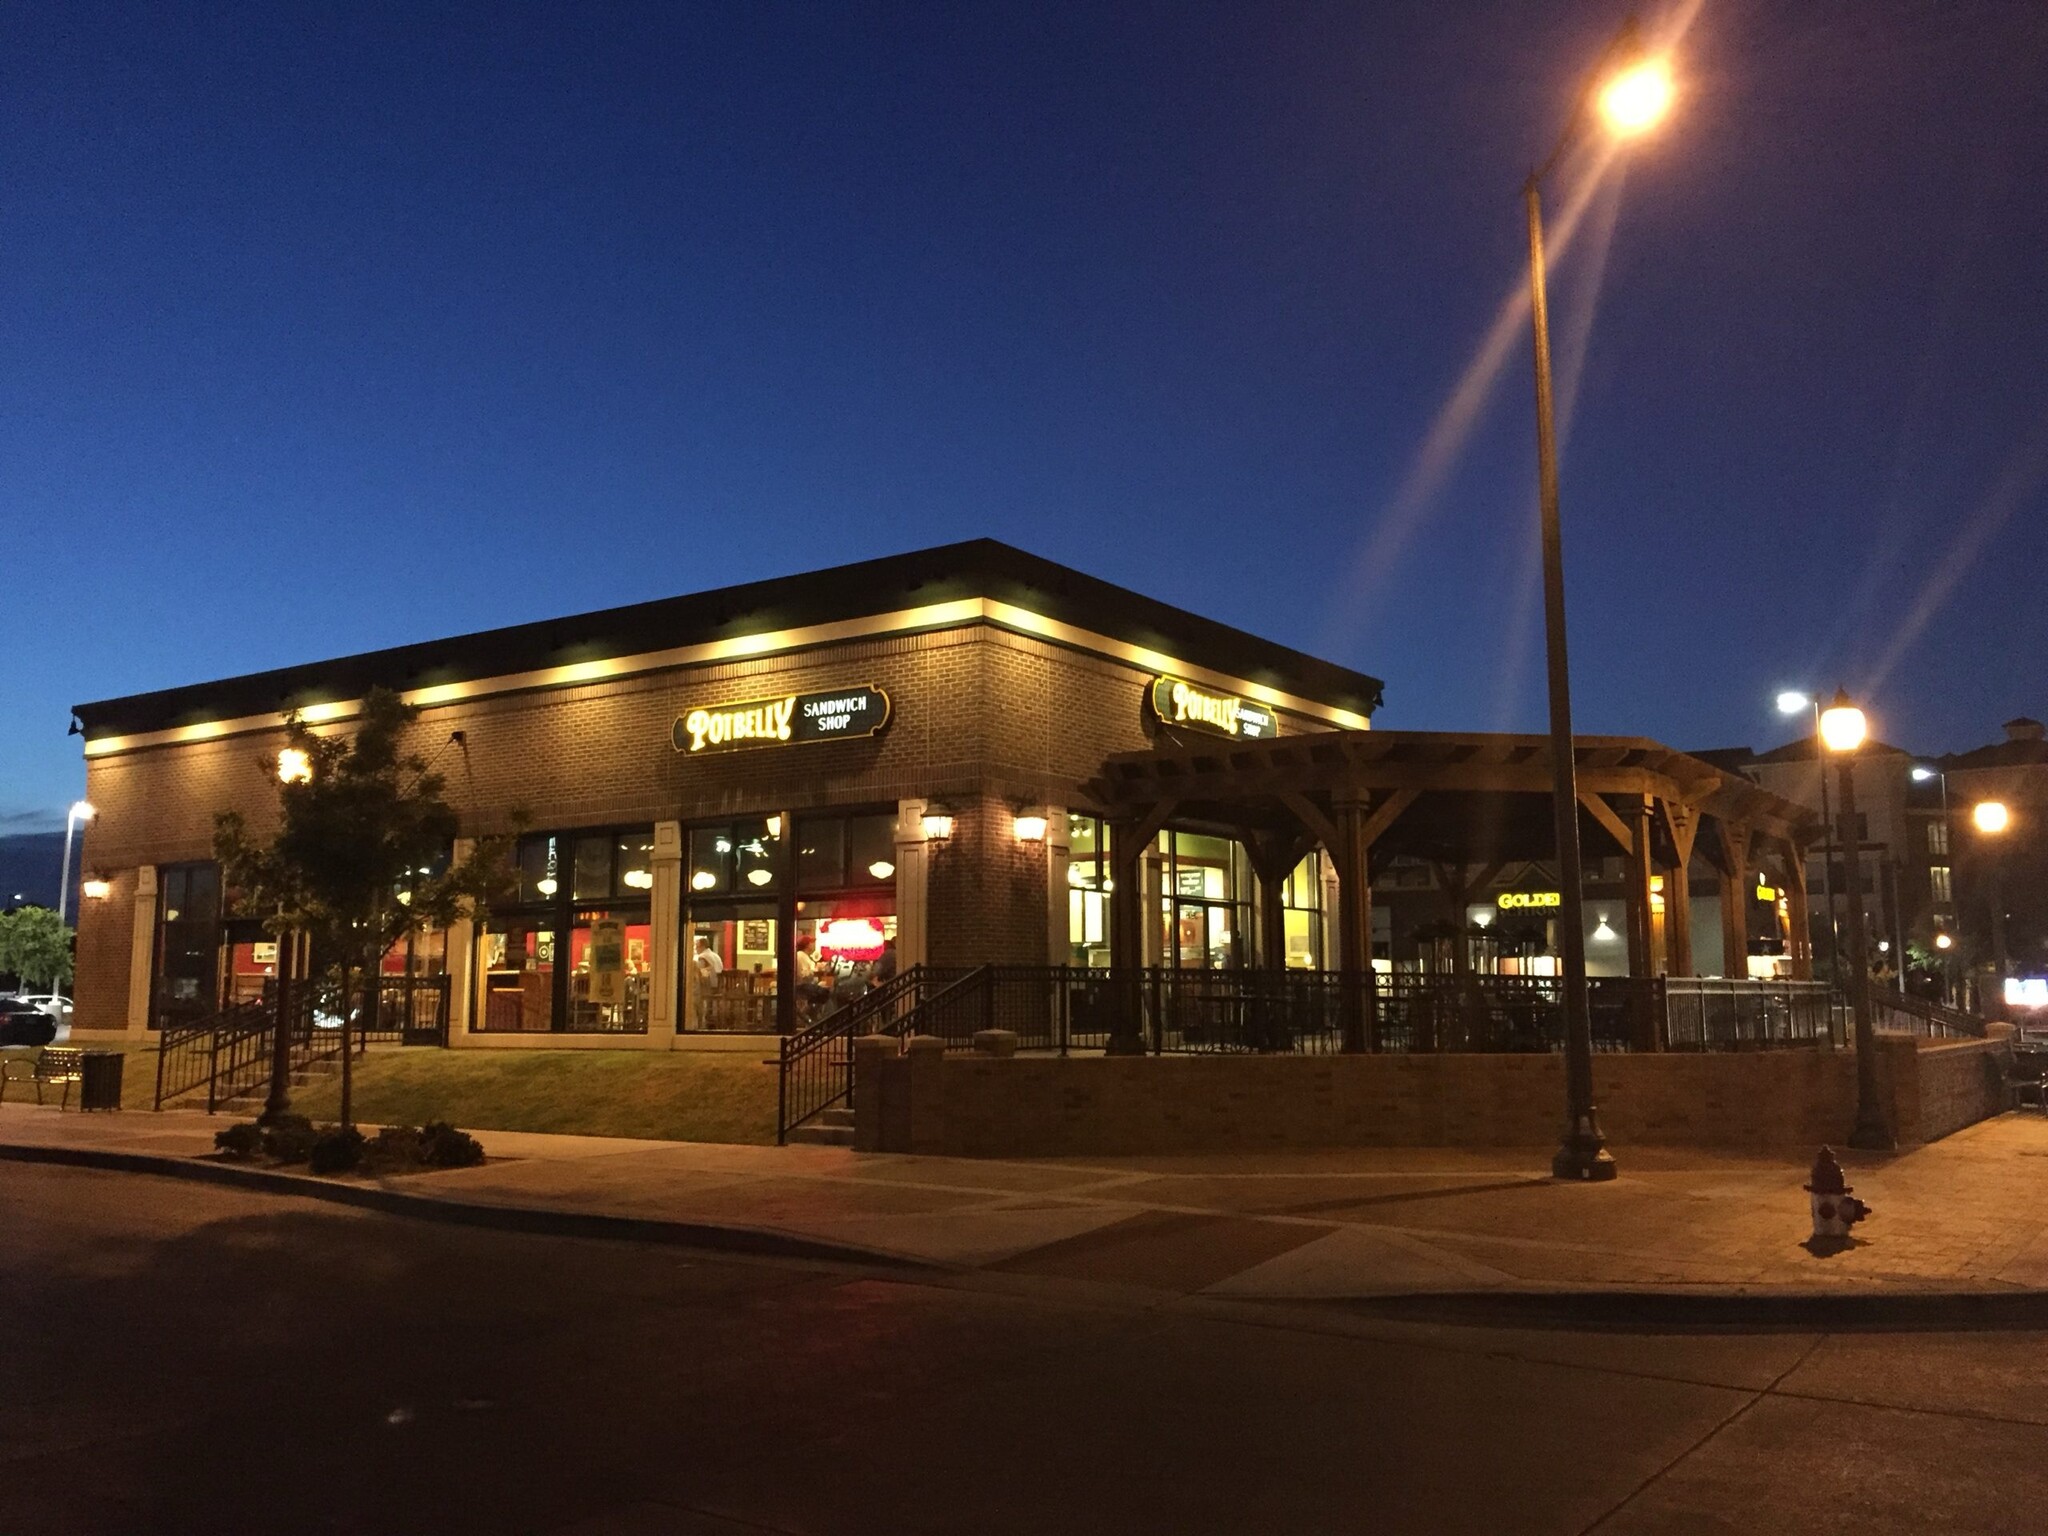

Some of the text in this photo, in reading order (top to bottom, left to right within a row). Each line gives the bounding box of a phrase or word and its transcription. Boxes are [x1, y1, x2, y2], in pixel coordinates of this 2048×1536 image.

[804, 696, 867, 717] SANDWICH
[687, 696, 796, 751] POTBELLY
[818, 714, 851, 731] SHOP
[1498, 893, 1560, 909] GOLDE
